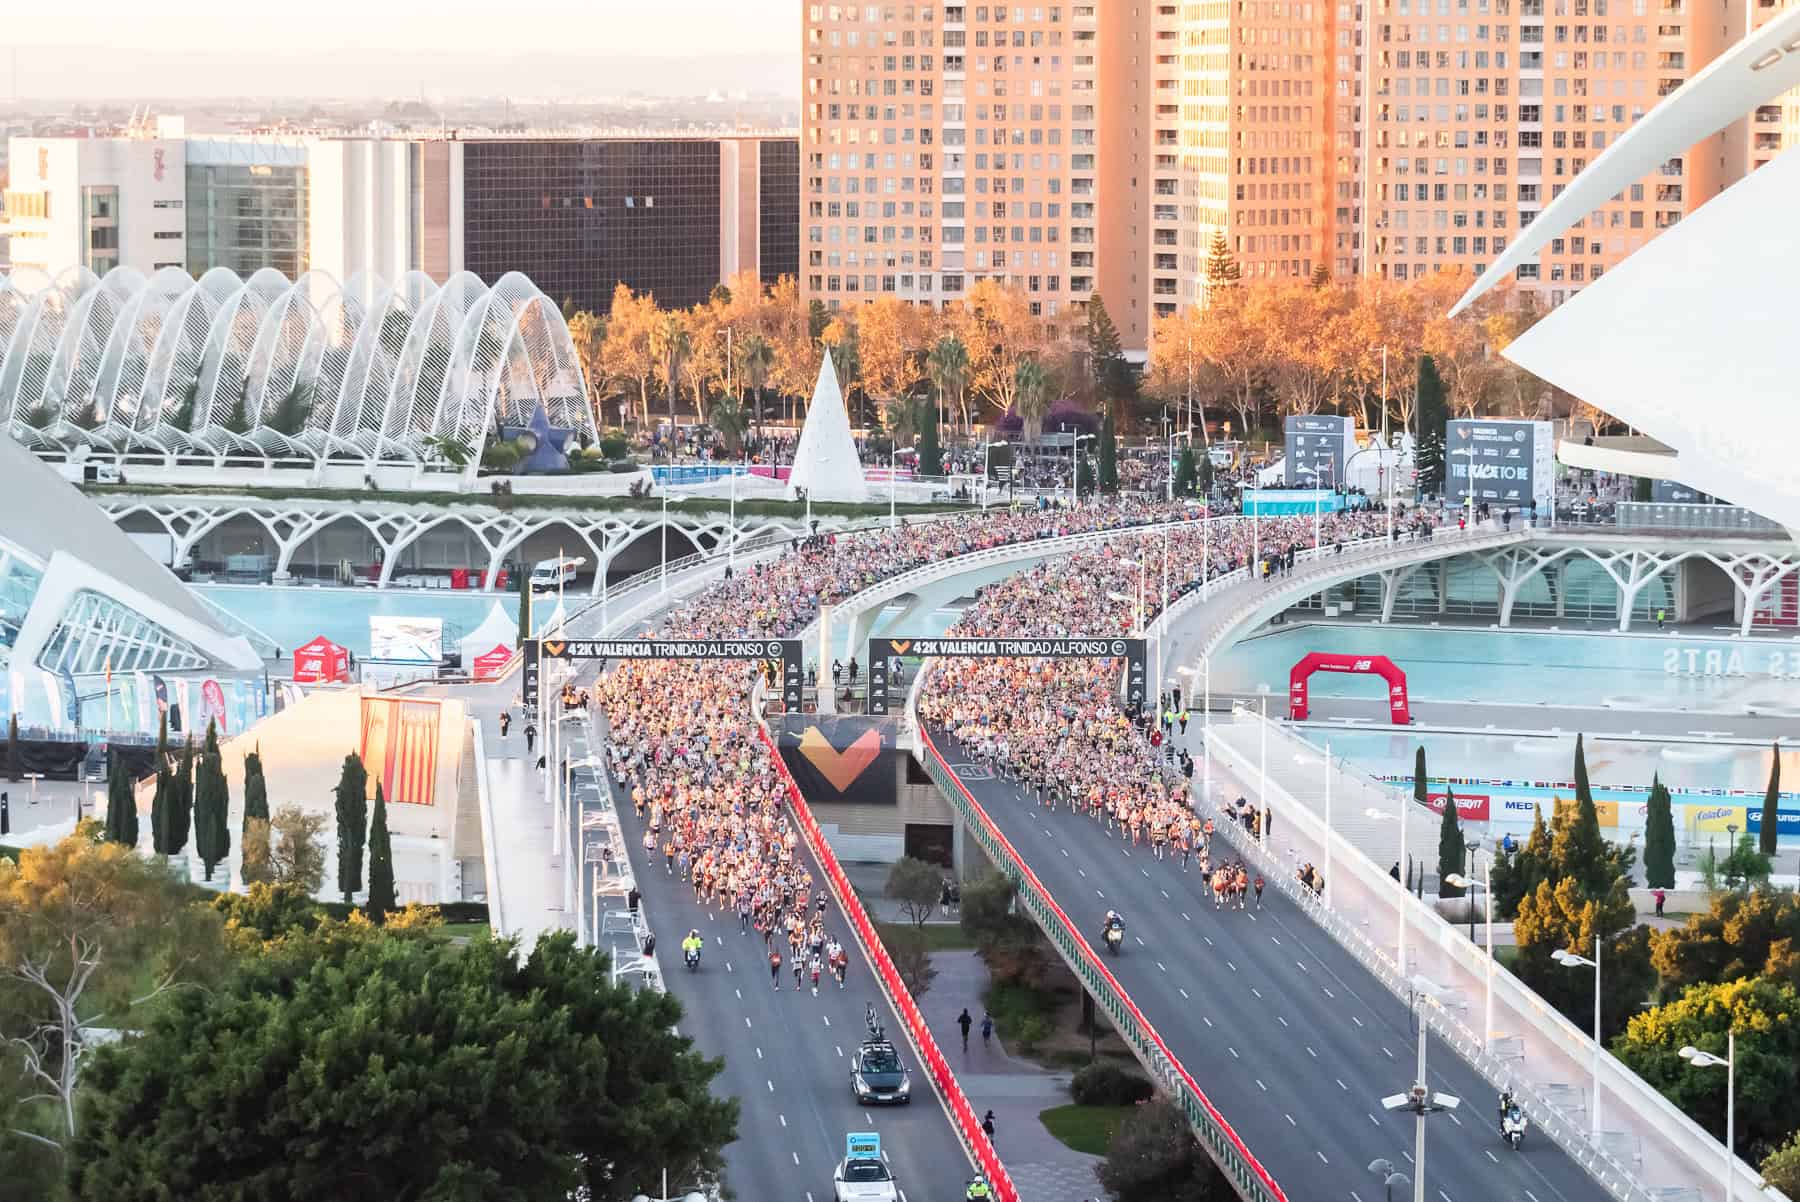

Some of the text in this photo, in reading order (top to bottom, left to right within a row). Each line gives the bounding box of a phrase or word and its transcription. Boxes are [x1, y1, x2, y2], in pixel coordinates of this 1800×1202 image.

[568, 642, 764, 657] 42K VALENCIA TRINIDAD ALFONSO
[912, 641, 1108, 655] 42K VALENCIA TRINIDAD ALFONSO
